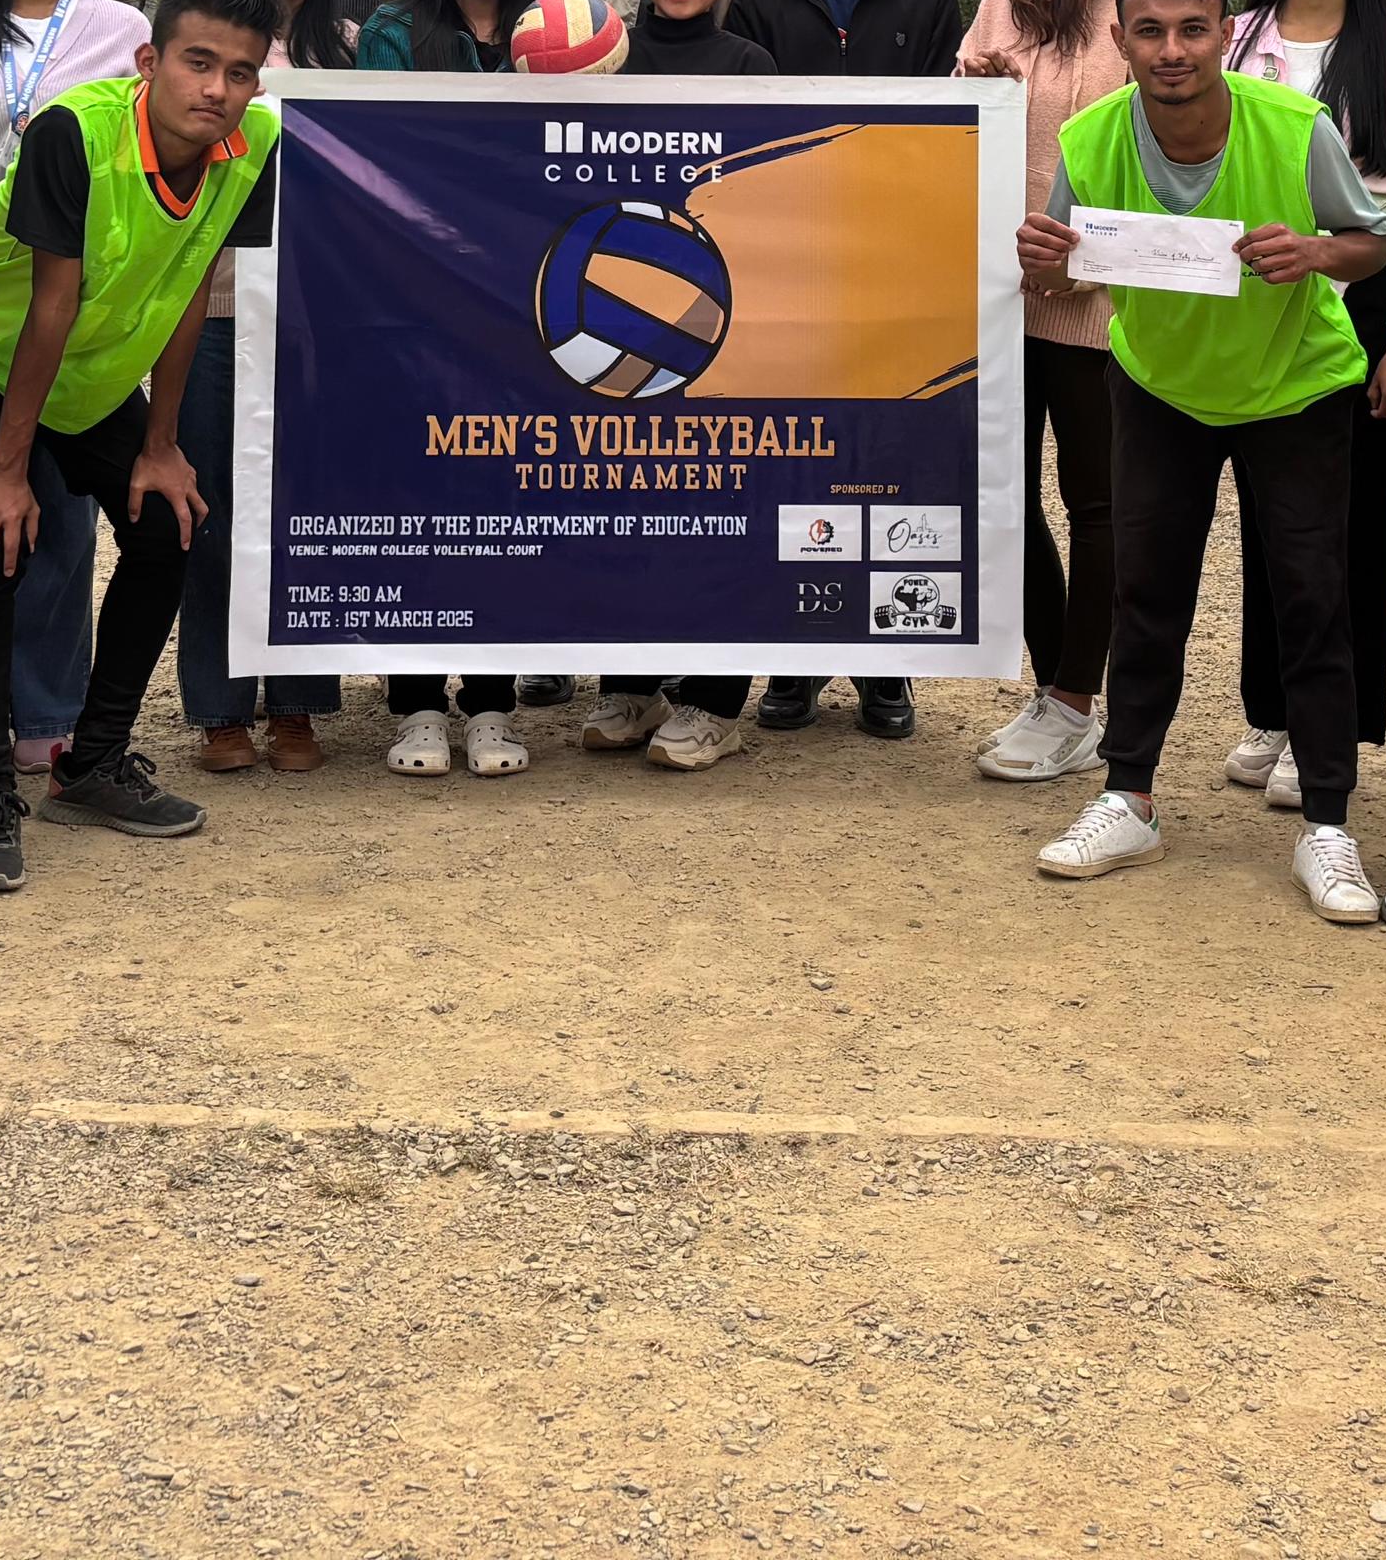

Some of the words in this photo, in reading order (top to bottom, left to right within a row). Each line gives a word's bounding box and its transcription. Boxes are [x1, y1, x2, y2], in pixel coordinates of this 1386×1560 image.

[591, 131, 723, 154] MODERN
[544, 164, 723, 183] COLLEGE
[425, 415, 558, 456] MEN'S
[570, 415, 835, 457] VOLLEYBALL
[515, 463, 747, 490] TOURNAMENT
[830, 484, 884, 494] SPONSORED
[887, 484, 900, 494] BY
[289, 515, 395, 536] ORGANIZED
[400, 515, 426, 536] BY
[431, 515, 471, 536] THE
[476, 515, 609, 536] DEPARTMENT
[613, 515, 637, 536] OF
[641, 515, 748, 536] EDUCATION
[288, 544, 329, 556] VENUE:
[332, 544, 378, 556] MODERN
[381, 544, 430, 556] COLLEGE
[433, 544, 503, 556] VOLLEYBALL
[506, 544, 543, 556] COURT
[903, 578, 929, 587] POWER
[288, 585, 334, 603] TIME:
[338, 585, 370, 603] 9:30
[374, 585, 402, 603] AM
[796, 582, 843, 613] DS
[287, 611, 331, 628] DATE
[344, 611, 370, 628] 1ST
[374, 611, 433, 628] MARCH
[437, 610, 474, 628] 2025
[902, 615, 930, 628] GYM
